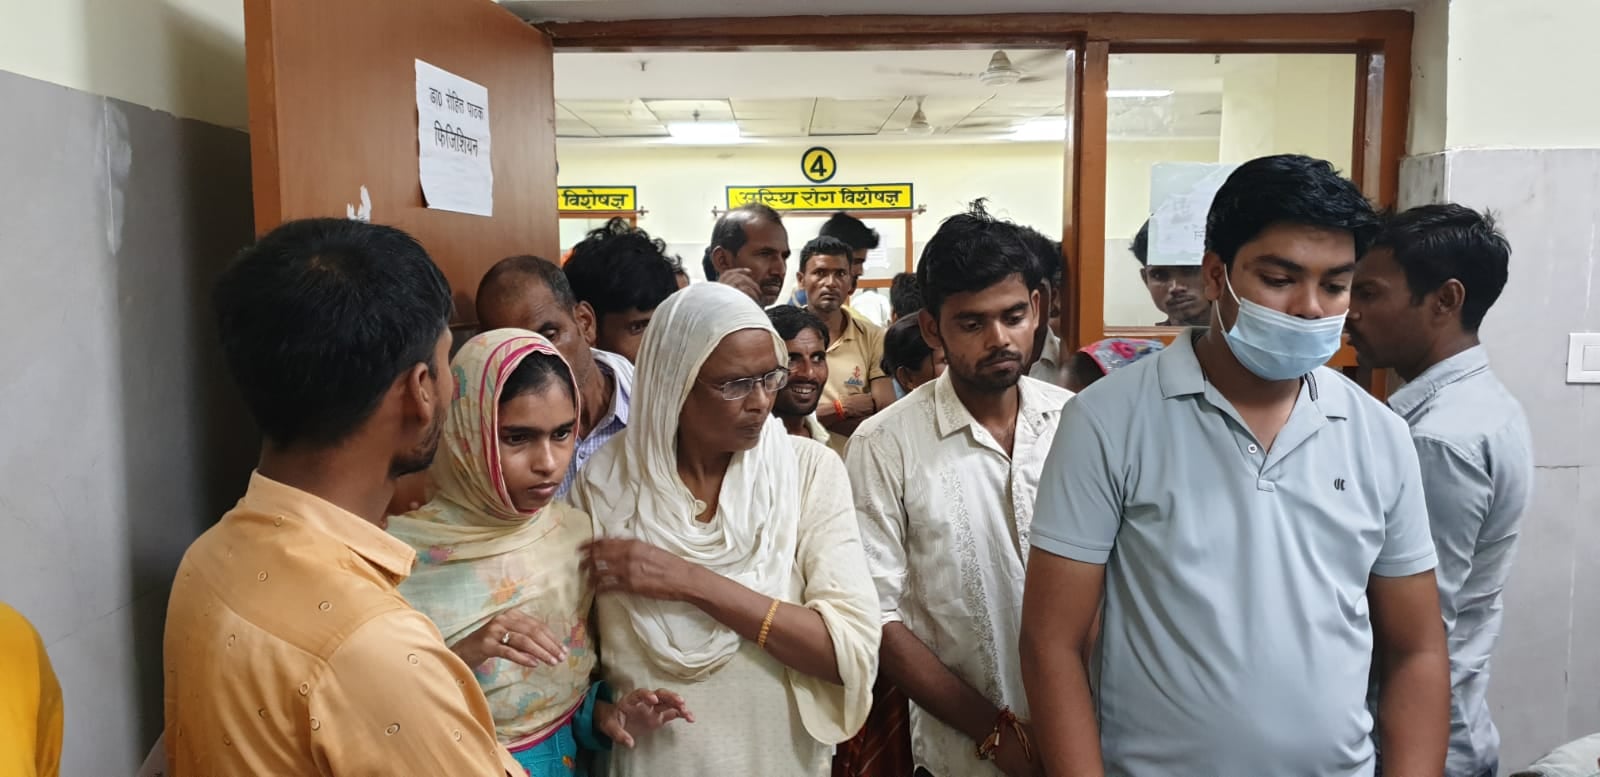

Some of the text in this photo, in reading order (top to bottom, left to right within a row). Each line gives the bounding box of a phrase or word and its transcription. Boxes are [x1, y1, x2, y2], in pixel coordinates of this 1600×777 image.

[445, 89, 464, 114] रोहित
[467, 101, 484, 121] पाठक
[434, 120, 478, 158] फिजिशियन
[809, 154, 827, 177] 4
[561, 189, 629, 209] विशेषज्ञ
[801, 188, 836, 206] रोग
[839, 187, 902, 206] विशेषज्ञ
